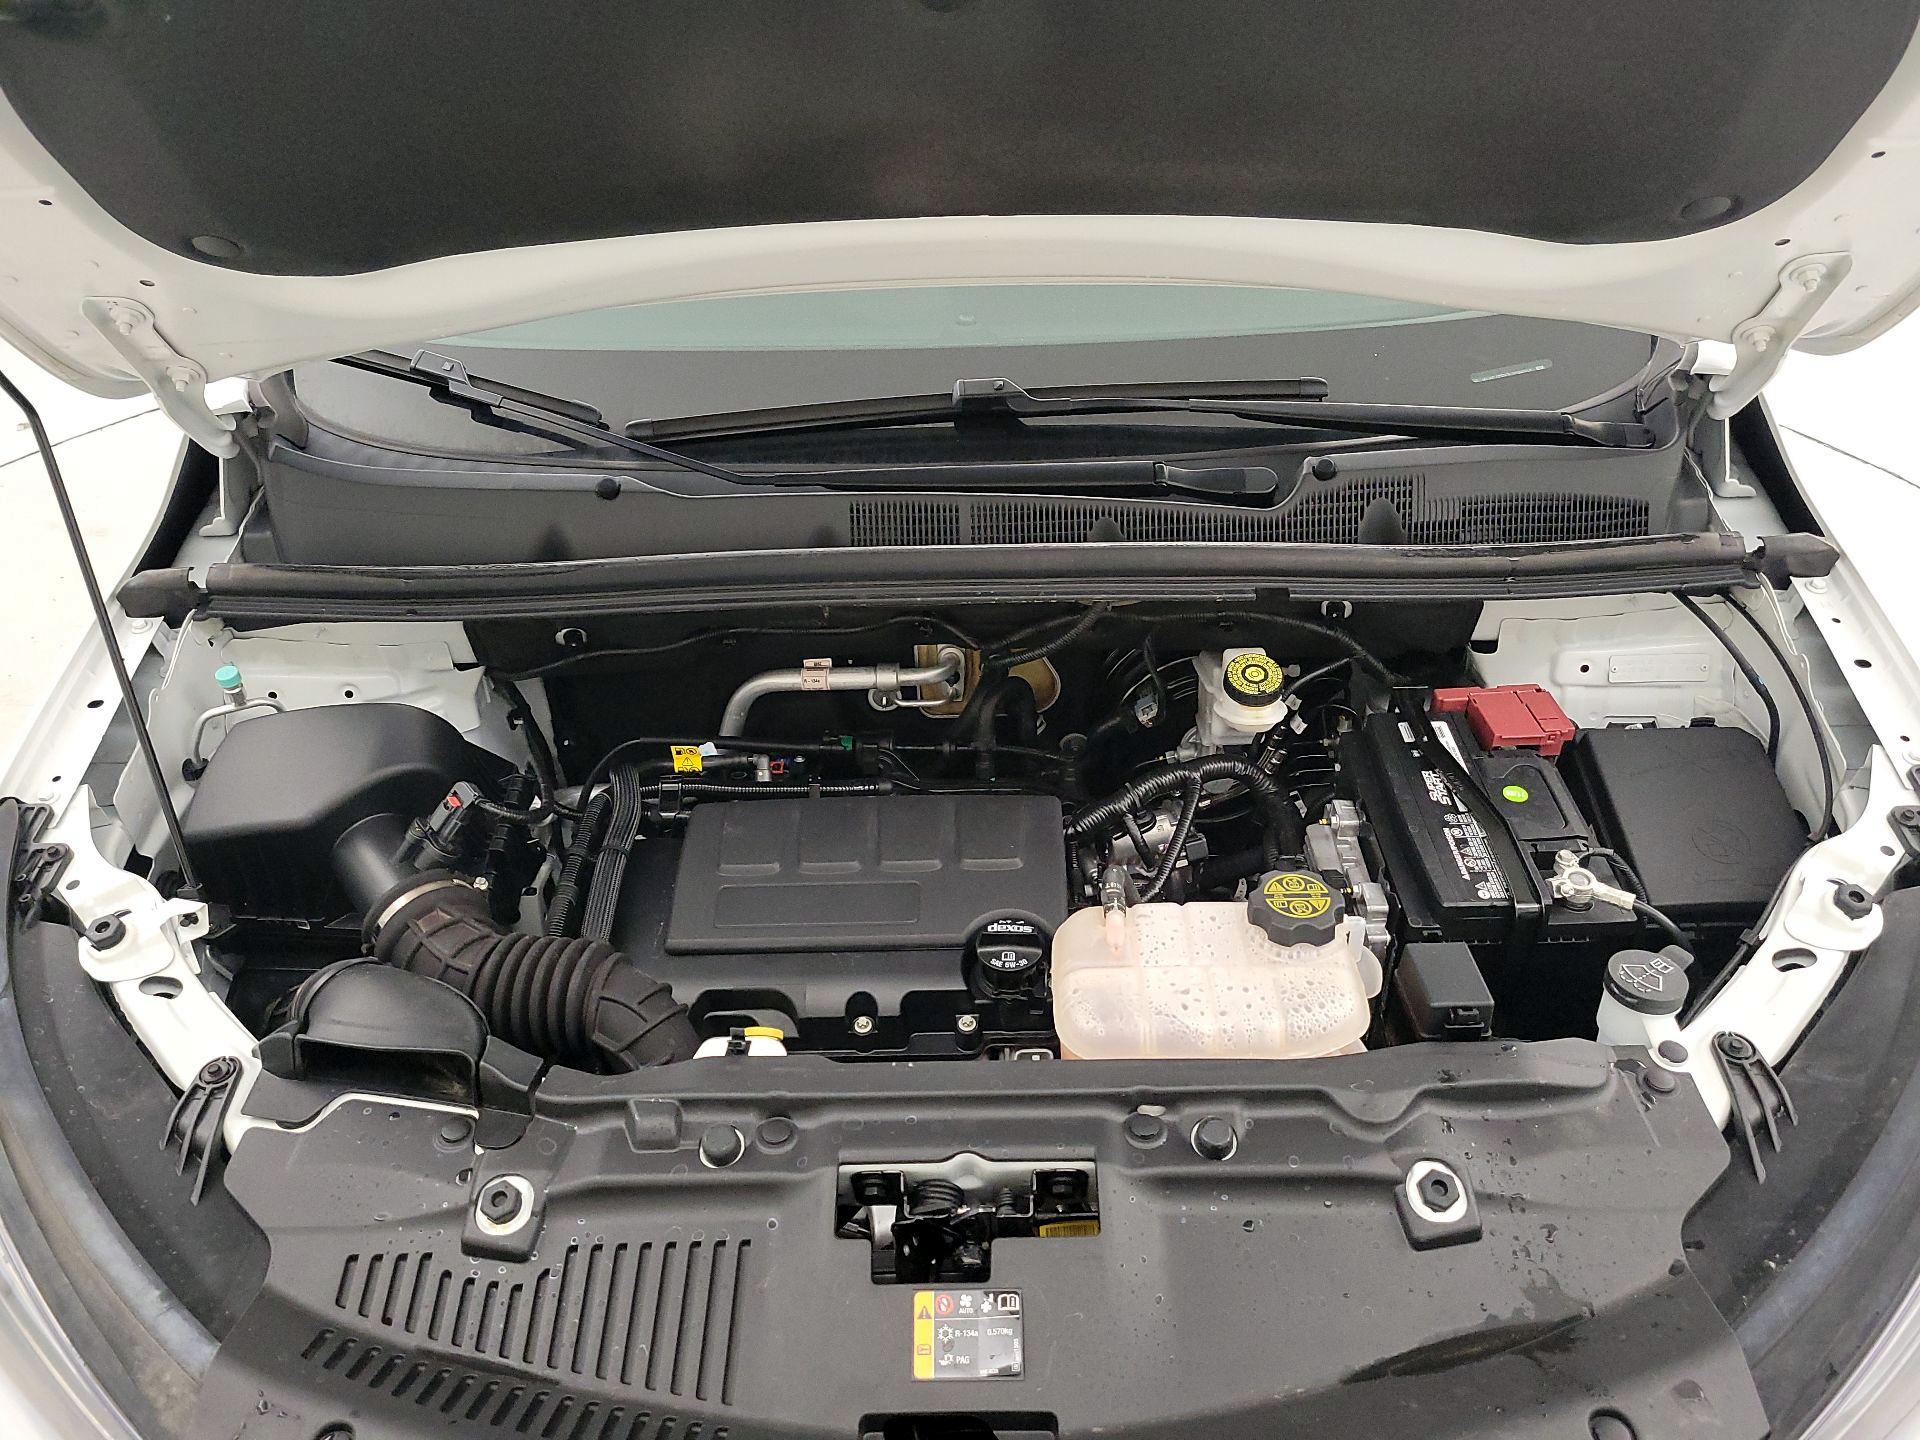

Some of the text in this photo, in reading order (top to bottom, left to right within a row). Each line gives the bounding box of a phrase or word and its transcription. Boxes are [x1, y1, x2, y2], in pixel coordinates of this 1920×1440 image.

[1421, 770, 1439, 801] SUPER
[1431, 770, 1452, 805] START
[987, 923, 1034, 932] dexos
[990, 958, 1003, 968] SAE
[955, 1329, 979, 1337] R-134a
[956, 1355, 970, 1364] PAG
